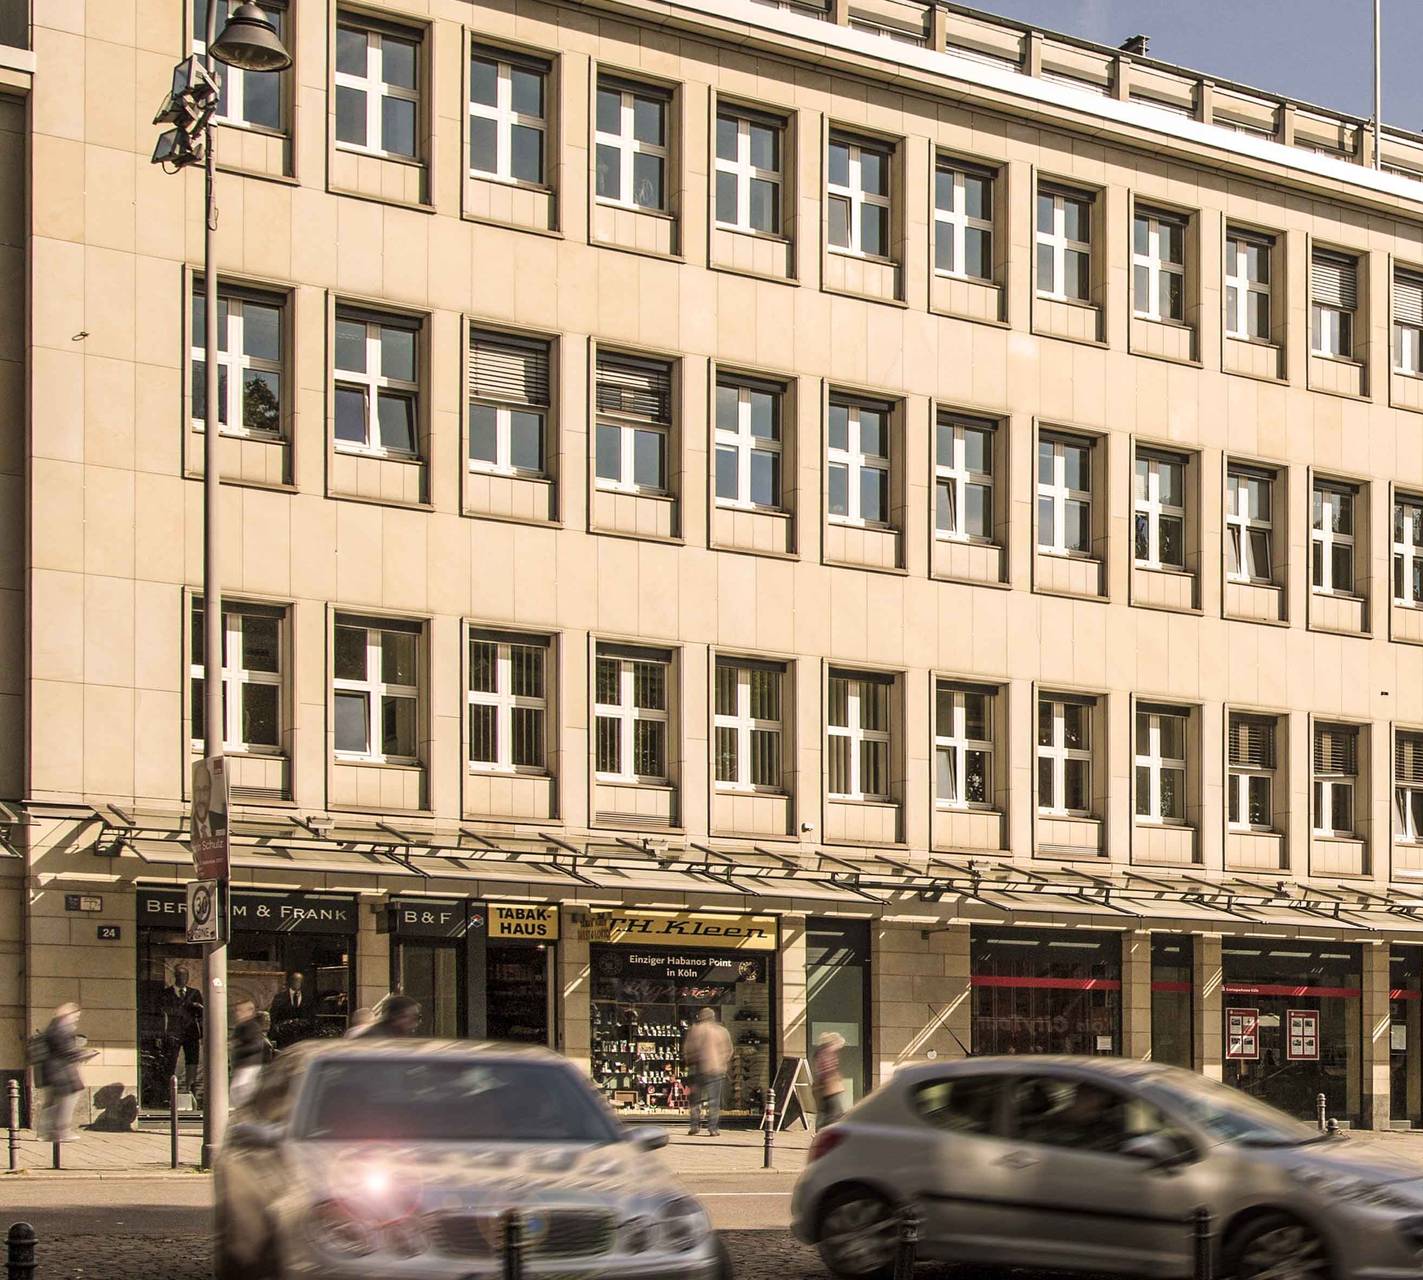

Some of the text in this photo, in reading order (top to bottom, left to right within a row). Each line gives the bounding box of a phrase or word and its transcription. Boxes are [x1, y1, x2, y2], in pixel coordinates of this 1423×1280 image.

[147, 900, 347, 920] BERM & FRANK
[496, 907, 551, 921] TABAK-
[405, 911, 451, 924] B & F
[103, 928, 116, 938] 24
[500, 922, 547, 935] HAUS
[629, 955, 732, 967] Einziger Habanos Point
[666, 967, 698, 977] in Köln
